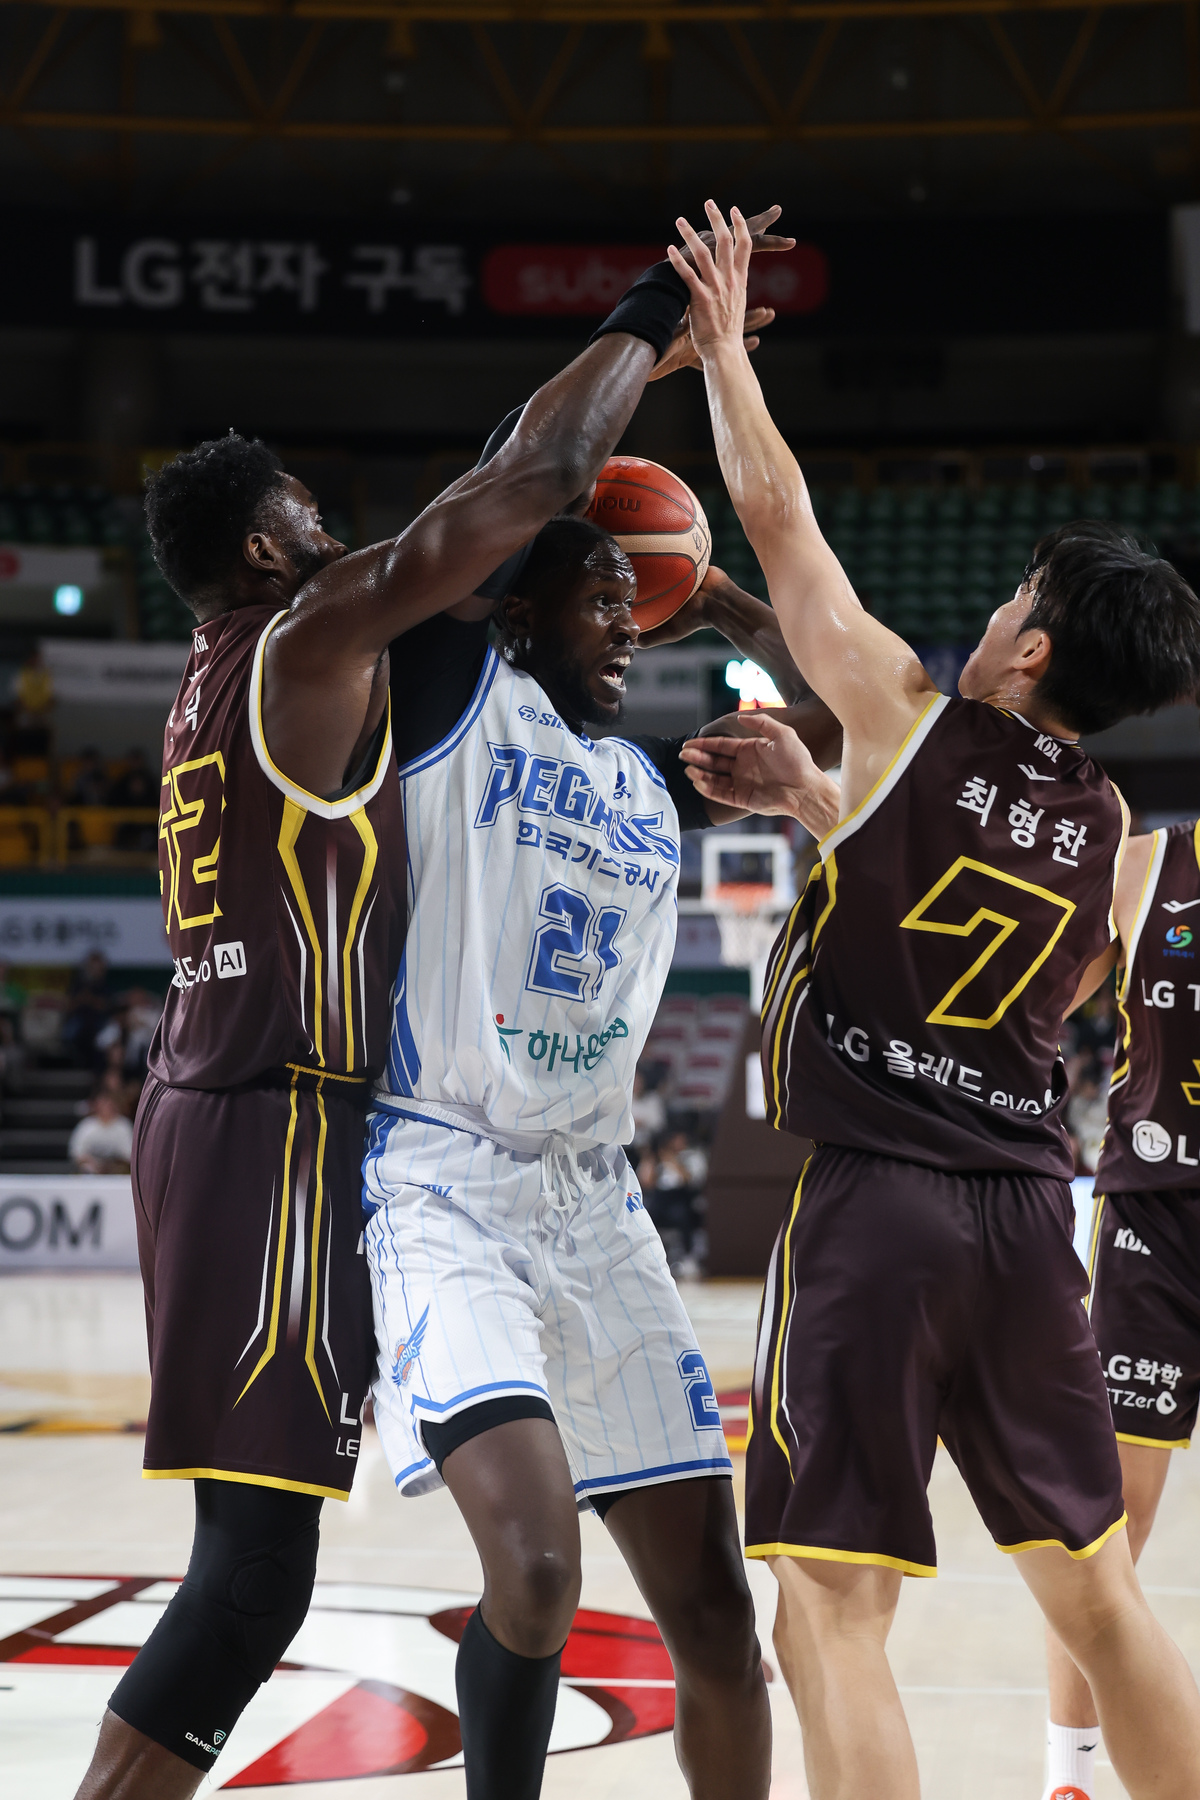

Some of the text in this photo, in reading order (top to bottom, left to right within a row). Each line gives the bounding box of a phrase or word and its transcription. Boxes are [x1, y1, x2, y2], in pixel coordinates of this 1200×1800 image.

[75, 238, 471, 314] LG전자 구독
[1033, 733, 1062, 764] KBL
[525, 881, 627, 1004] 21
[900, 855, 1076, 1030] 7
[1141, 978, 1175, 1009] LG
[826, 1013, 871, 1062] LG
